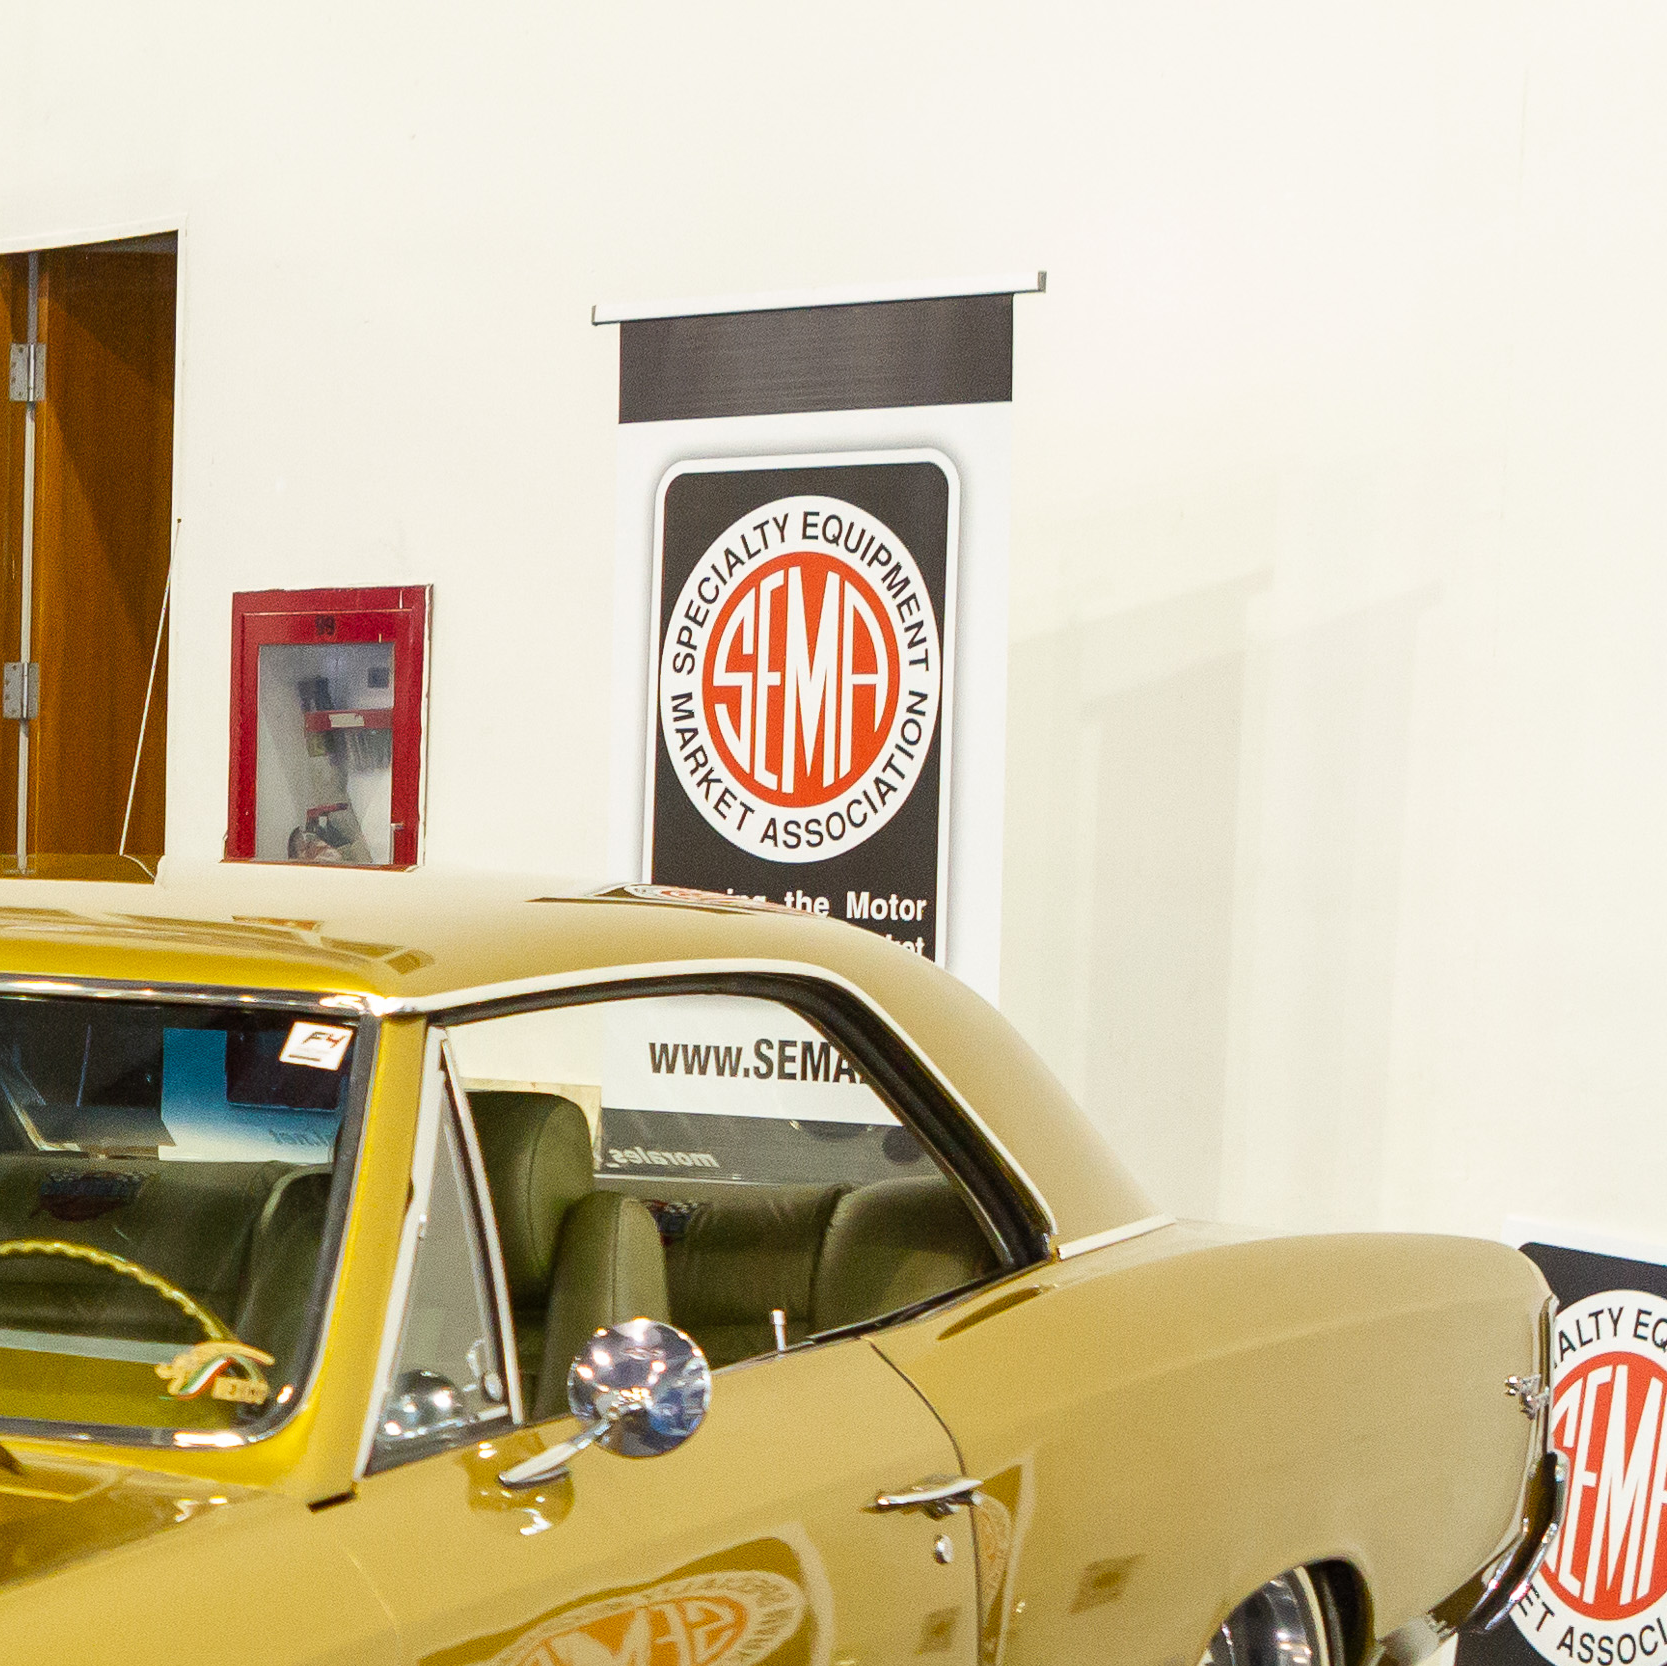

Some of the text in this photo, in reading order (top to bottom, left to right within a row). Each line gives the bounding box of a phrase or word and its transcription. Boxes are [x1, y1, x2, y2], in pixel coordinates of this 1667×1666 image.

[673, 511, 929, 676] SPECIALTY EQUIPMENT
[713, 566, 889, 794] SEMA
[671, 690, 929, 850] MARKET ASSOCIATION
[846, 890, 928, 921] Motor
